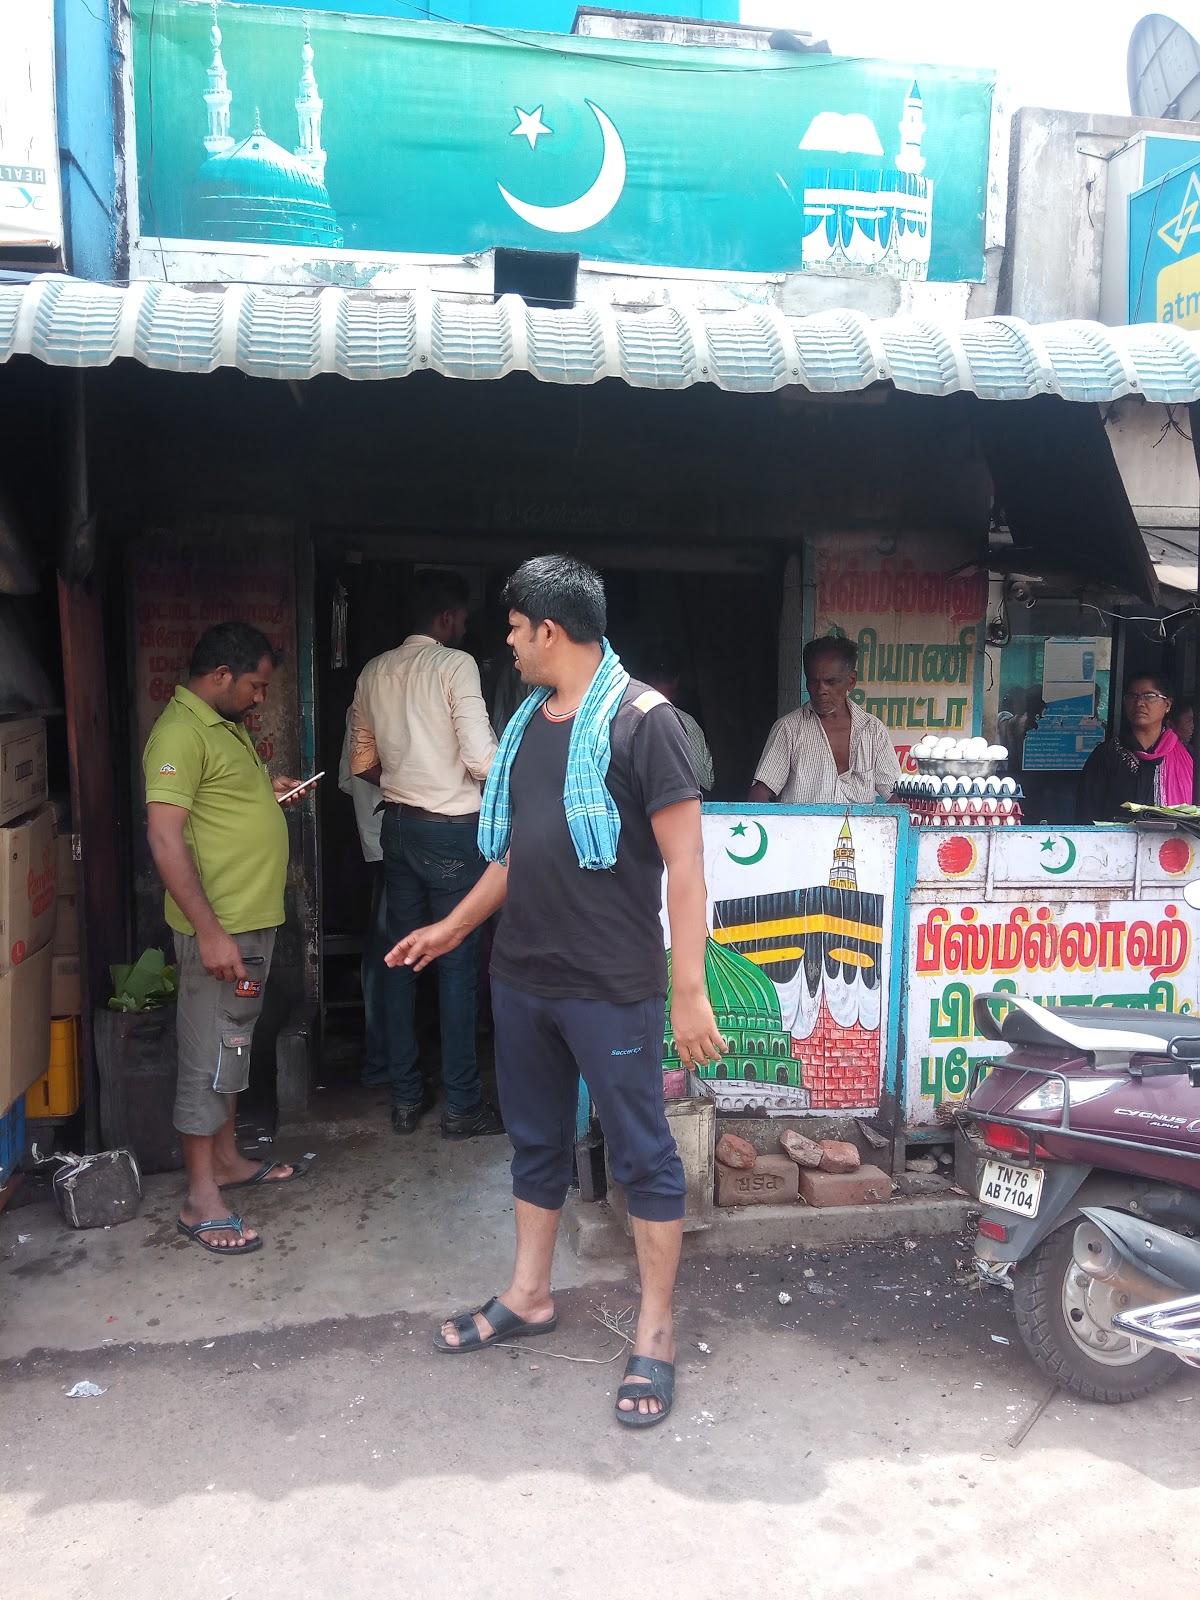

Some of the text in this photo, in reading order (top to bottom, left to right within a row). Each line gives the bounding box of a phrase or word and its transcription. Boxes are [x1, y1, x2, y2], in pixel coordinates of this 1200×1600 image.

[828, 625, 976, 684] ரியாணி
[915, 904, 1189, 981] பிஸ்மில்லாஹ்
[1113, 1108, 1187, 1124] CYGNUS
[1149, 1121, 1180, 1129] ALPHA
[997, 1166, 1029, 1188] TN 76
[985, 1182, 1033, 1210] AB 7104
